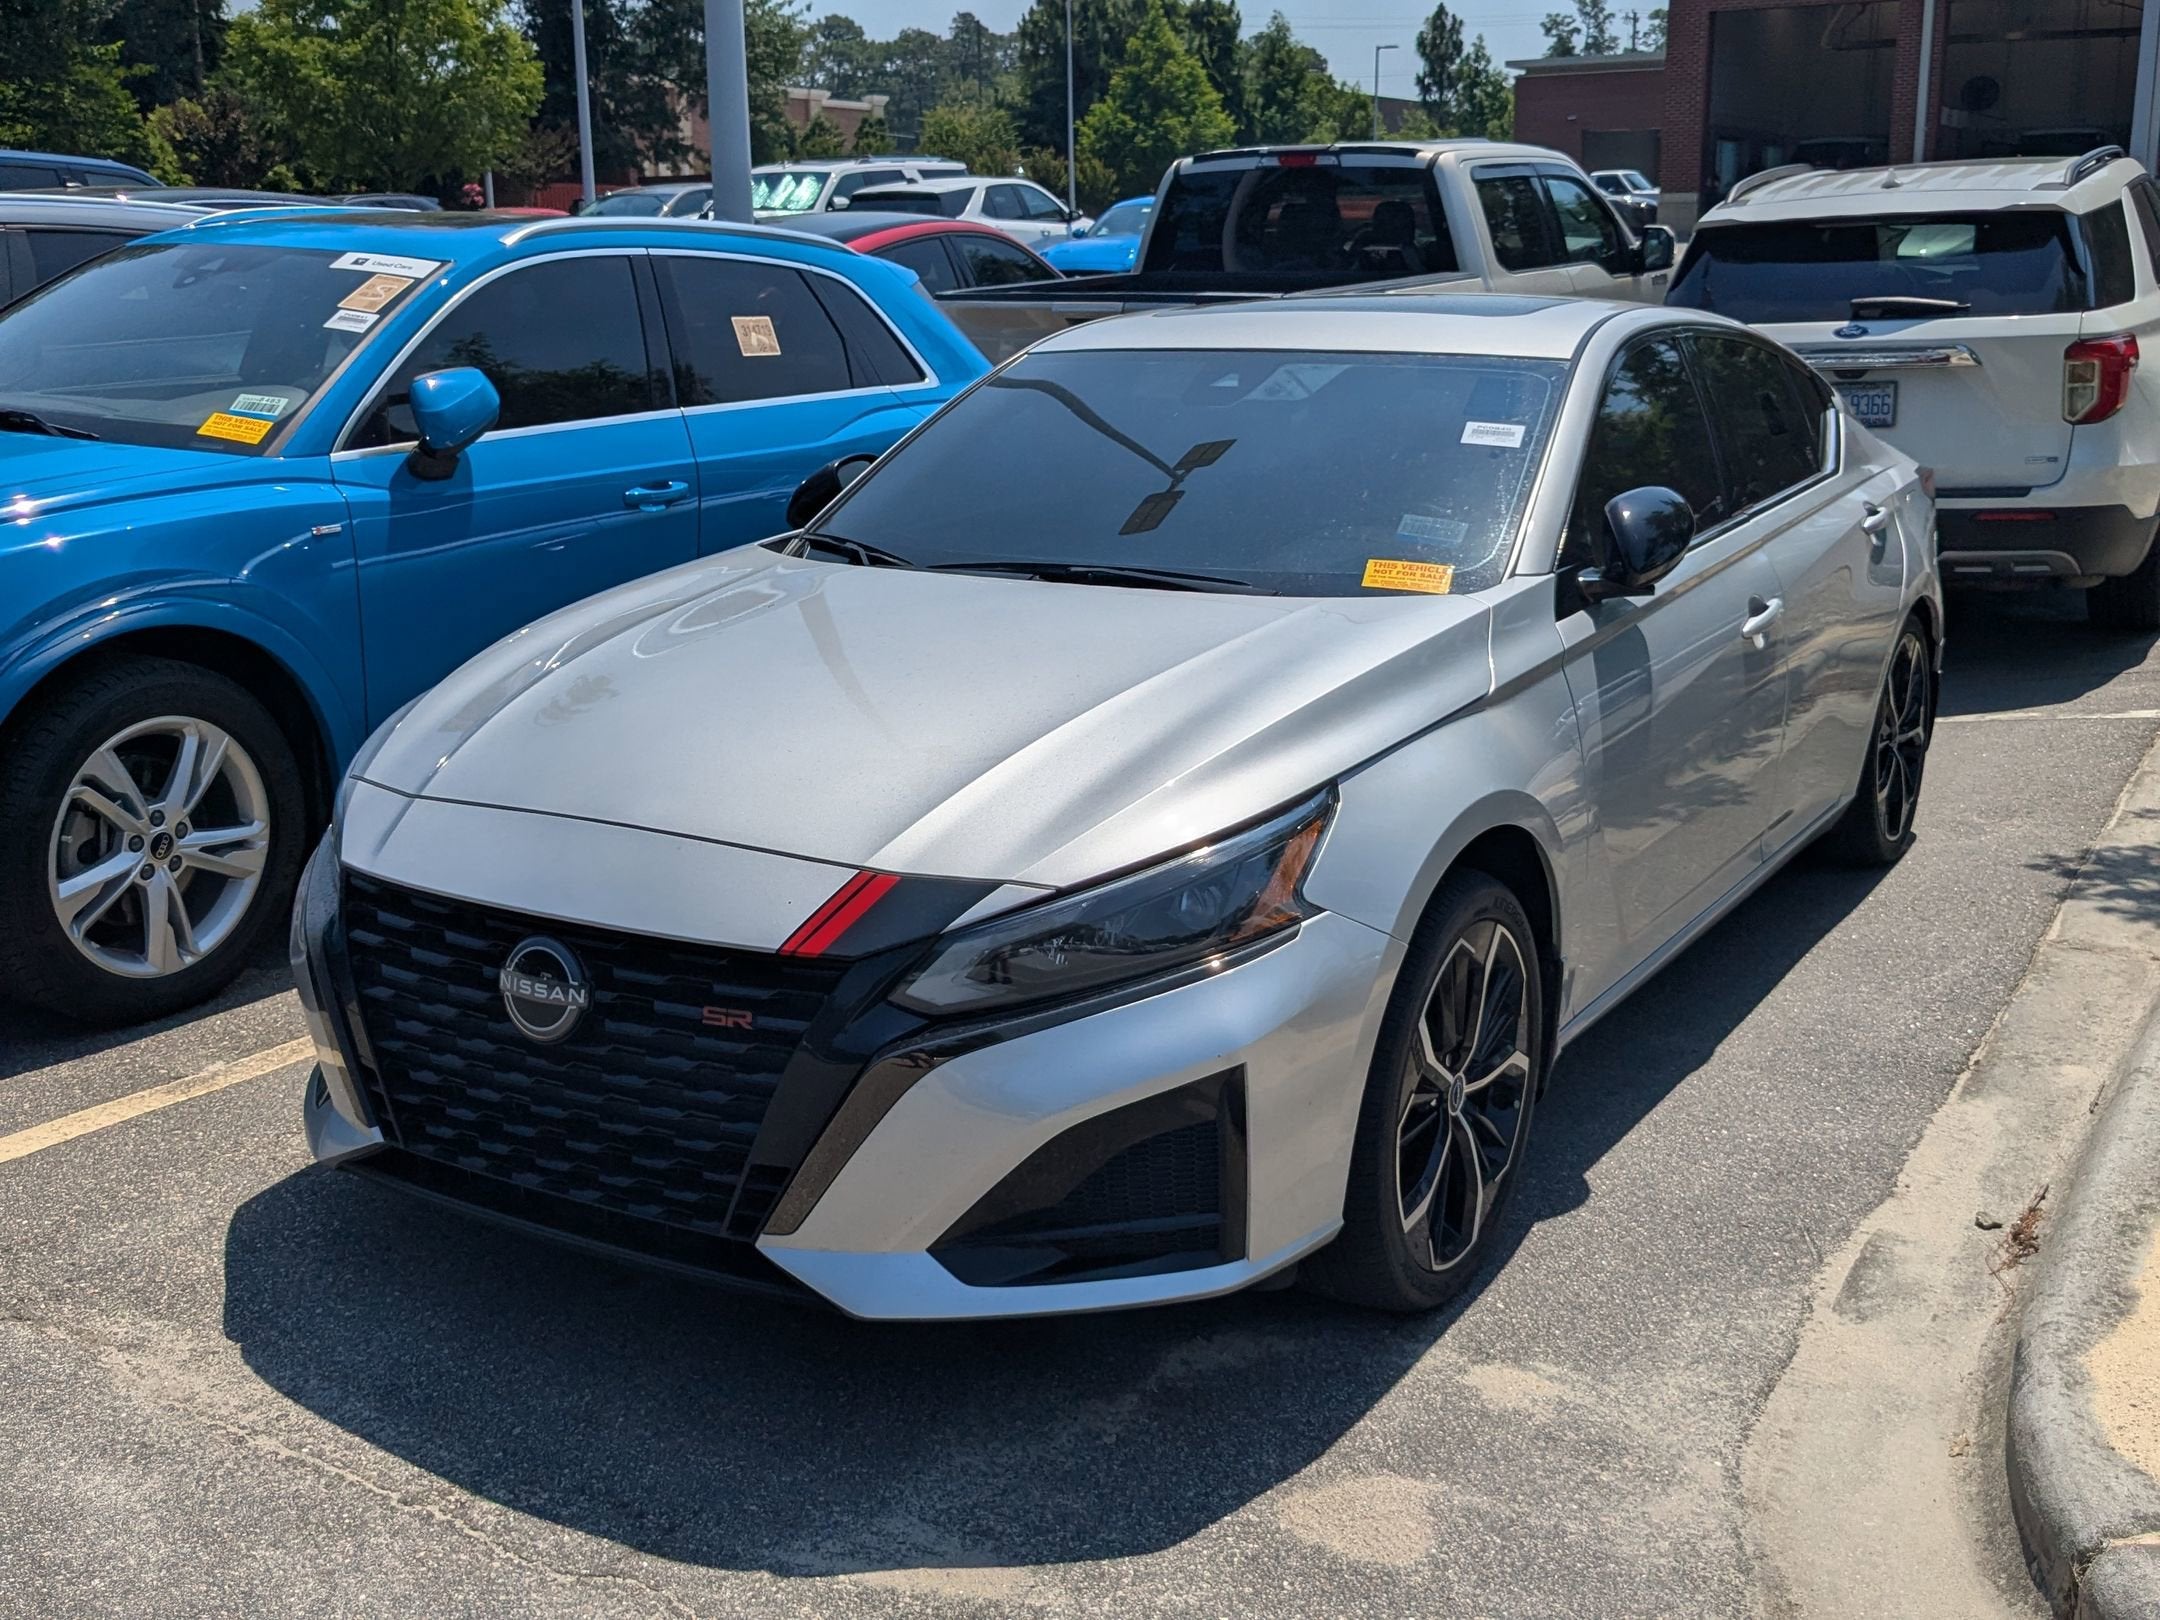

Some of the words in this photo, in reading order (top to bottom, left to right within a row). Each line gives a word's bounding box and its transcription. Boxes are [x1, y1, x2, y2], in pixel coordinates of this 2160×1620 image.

[394, 262, 413, 270] Cars
[1850, 394, 1891, 416] 9366
[234, 417, 269, 428] VEHICLE
[1372, 561, 1398, 569] THIS
[1401, 563, 1448, 575] VEHICLE
[1396, 570, 1417, 578] FOR
[1420, 572, 1446, 580] SALE
[500, 972, 585, 1003] NISSAN
[702, 1006, 753, 1029] SR
